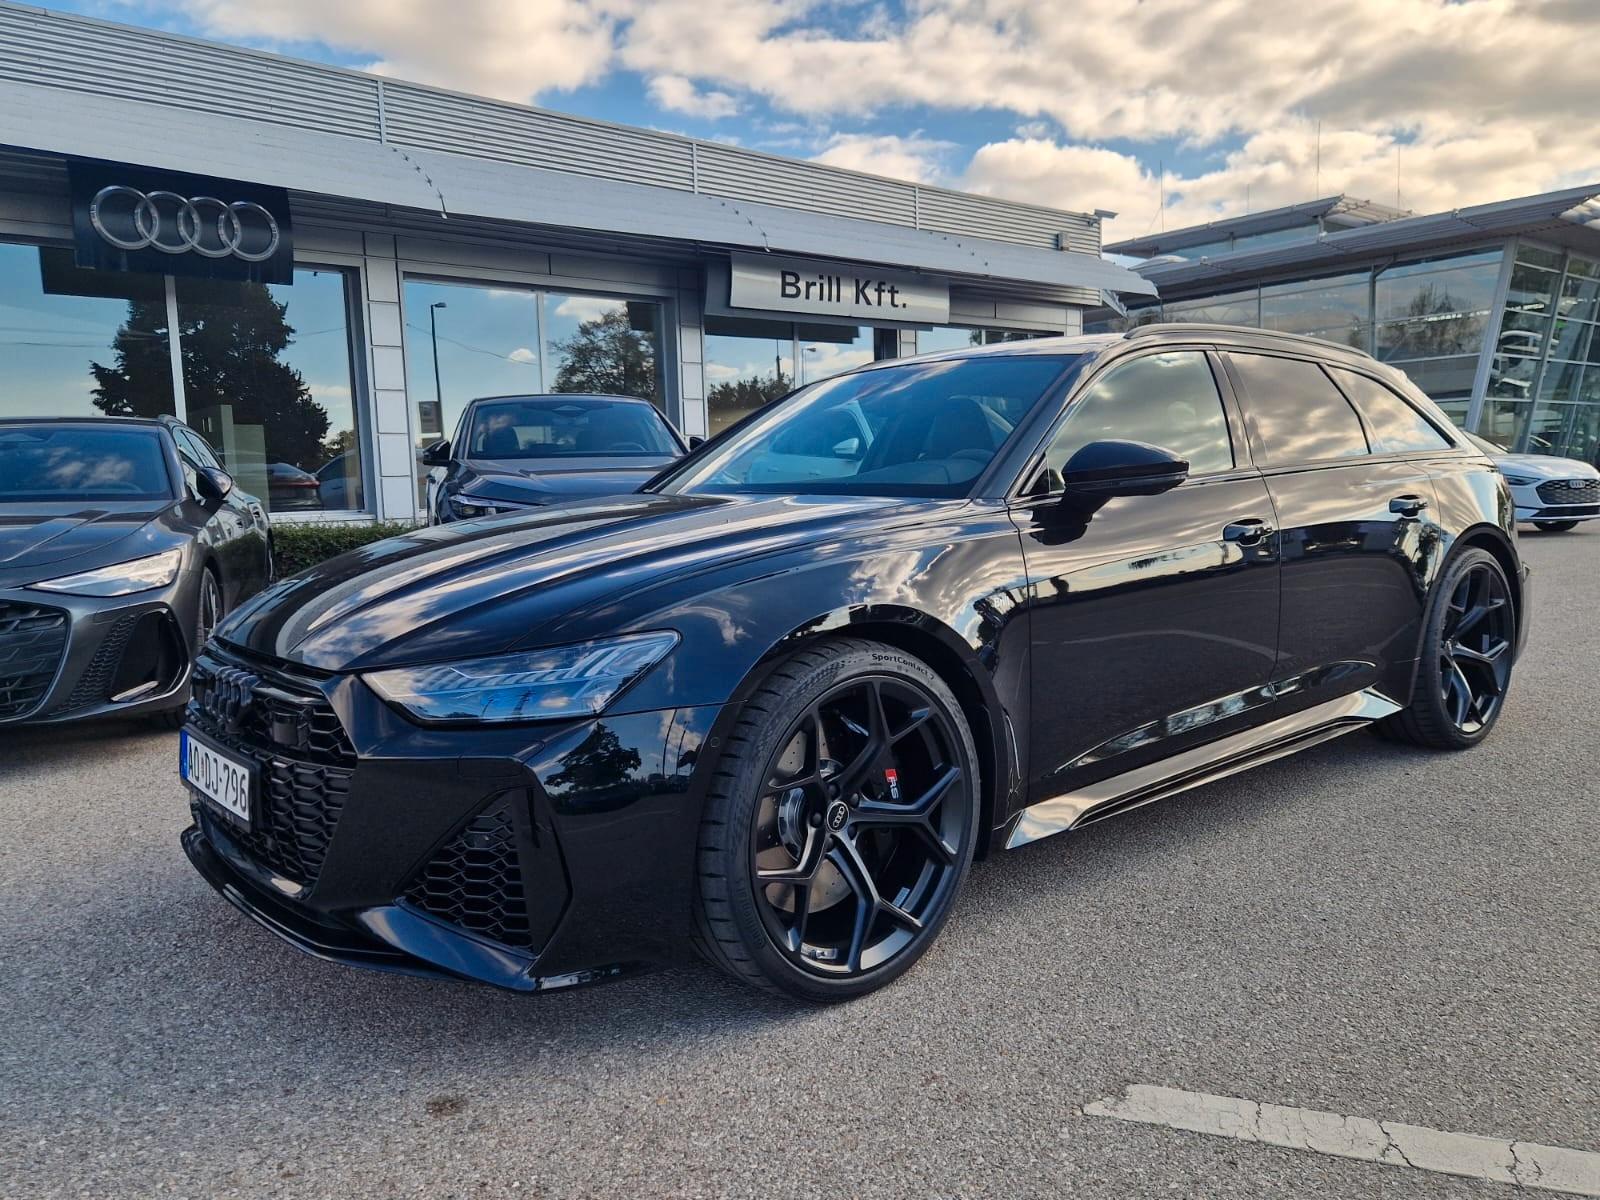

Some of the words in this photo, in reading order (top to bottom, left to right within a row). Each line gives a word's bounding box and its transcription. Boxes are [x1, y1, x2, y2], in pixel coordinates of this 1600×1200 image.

[781, 270, 841, 303] Brill
[855, 278, 907, 309] Kft.
[871, 653, 929, 676] SportContact
[886, 776, 899, 800] RS
